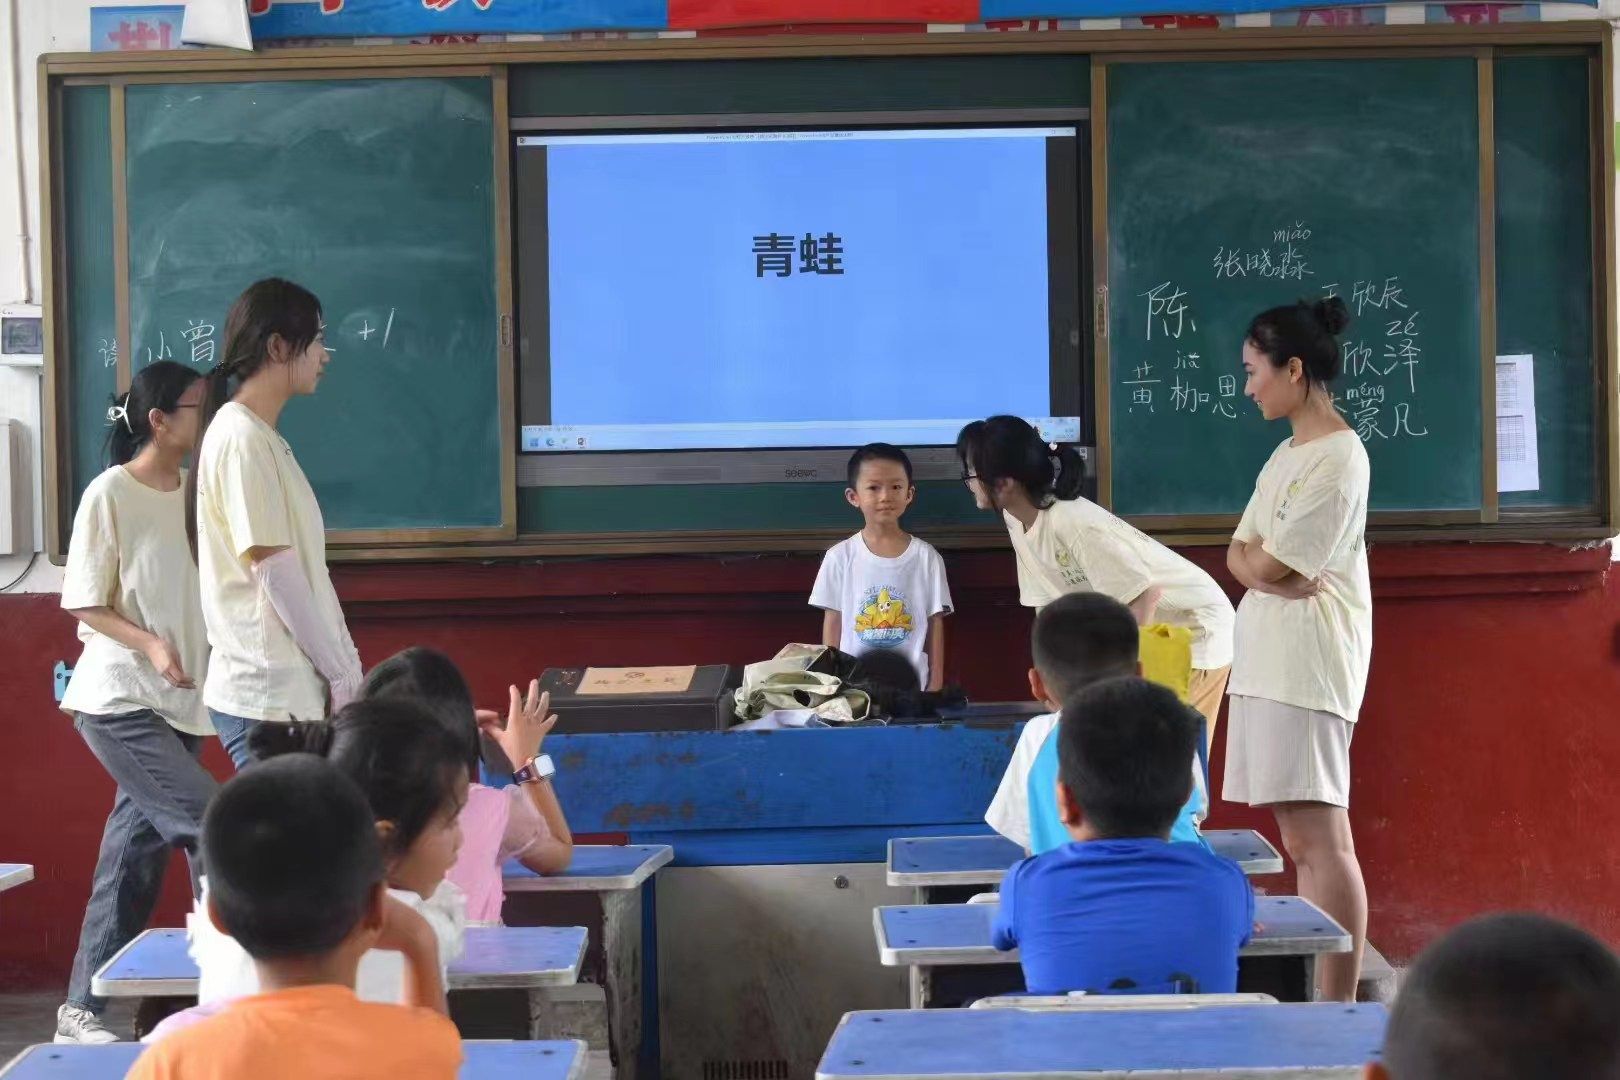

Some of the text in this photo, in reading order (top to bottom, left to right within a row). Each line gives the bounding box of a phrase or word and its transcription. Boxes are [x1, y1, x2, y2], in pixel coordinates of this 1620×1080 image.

[752, 232, 845, 277] 青蛙
[1137, 281, 1197, 341] 陈
[1385, 311, 1419, 337] zé
